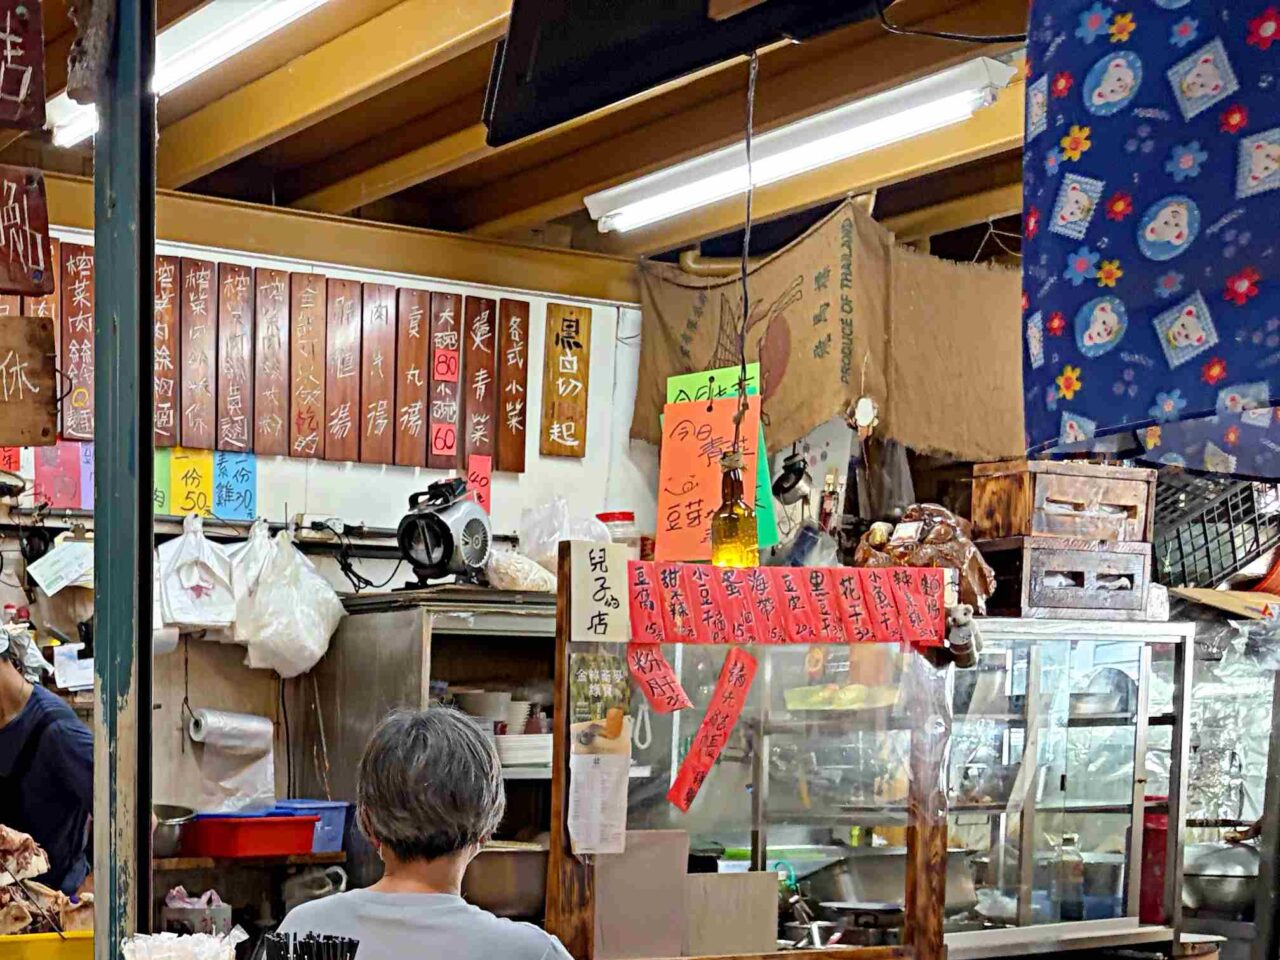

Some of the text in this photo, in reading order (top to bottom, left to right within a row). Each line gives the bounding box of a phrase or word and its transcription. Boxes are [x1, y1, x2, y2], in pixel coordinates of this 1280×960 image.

[435, 354, 457, 377] 80
[554, 317, 584, 398] 黑白切
[433, 427, 456, 450] 60
[586, 548, 620, 636] 兒子的店
